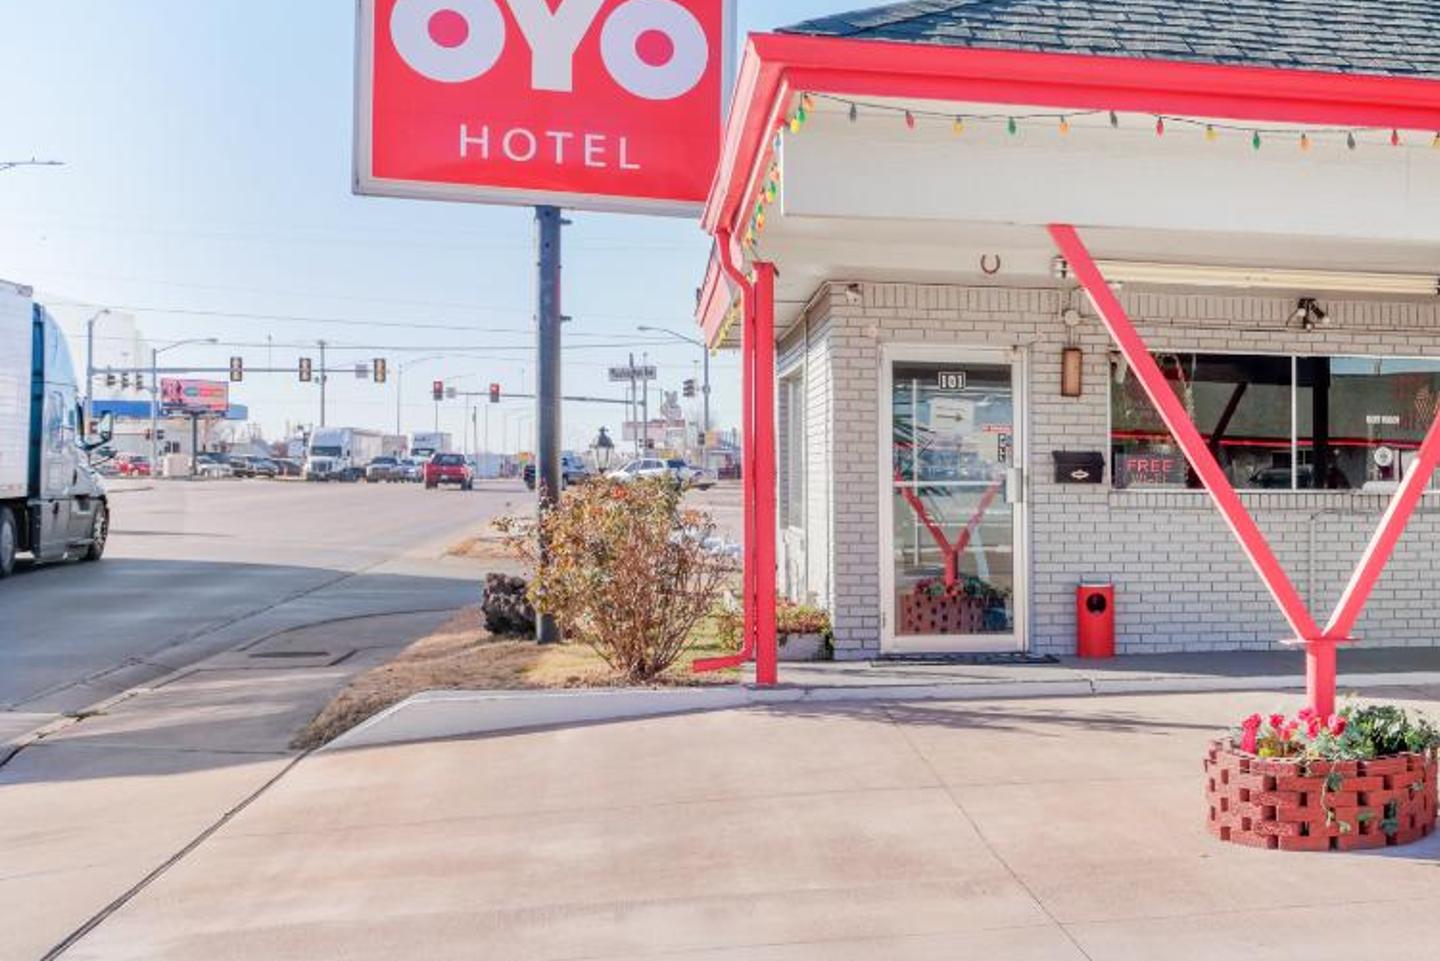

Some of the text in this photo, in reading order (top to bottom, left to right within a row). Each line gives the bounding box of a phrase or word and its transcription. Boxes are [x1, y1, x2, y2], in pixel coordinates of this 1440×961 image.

[459, 124, 640, 170] HOTEL
[941, 374, 963, 389] 101
[1126, 459, 1174, 472] FREE
